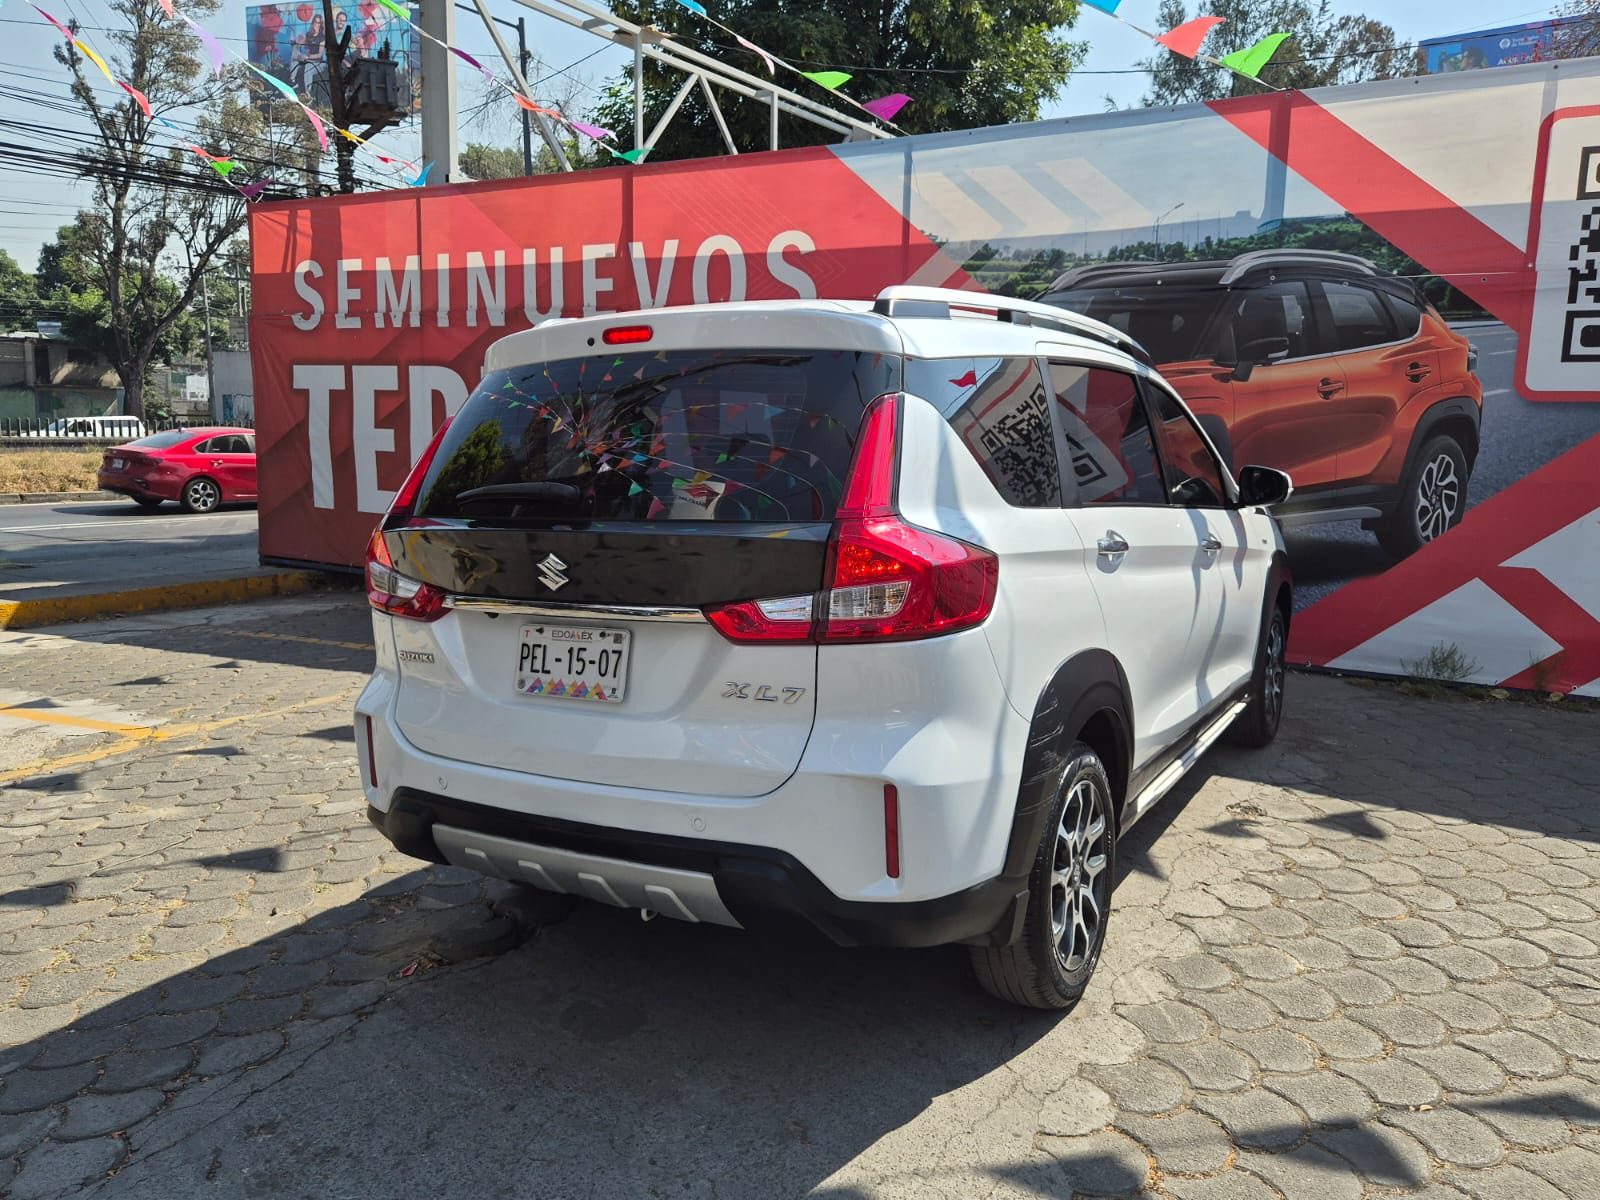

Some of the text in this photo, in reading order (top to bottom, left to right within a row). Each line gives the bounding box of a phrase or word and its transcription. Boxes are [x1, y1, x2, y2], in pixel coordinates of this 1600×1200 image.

[292, 230, 818, 331] SEMINUEVOS
[519, 643, 622, 678] PEL-15-07
[721, 681, 806, 704] XL7
